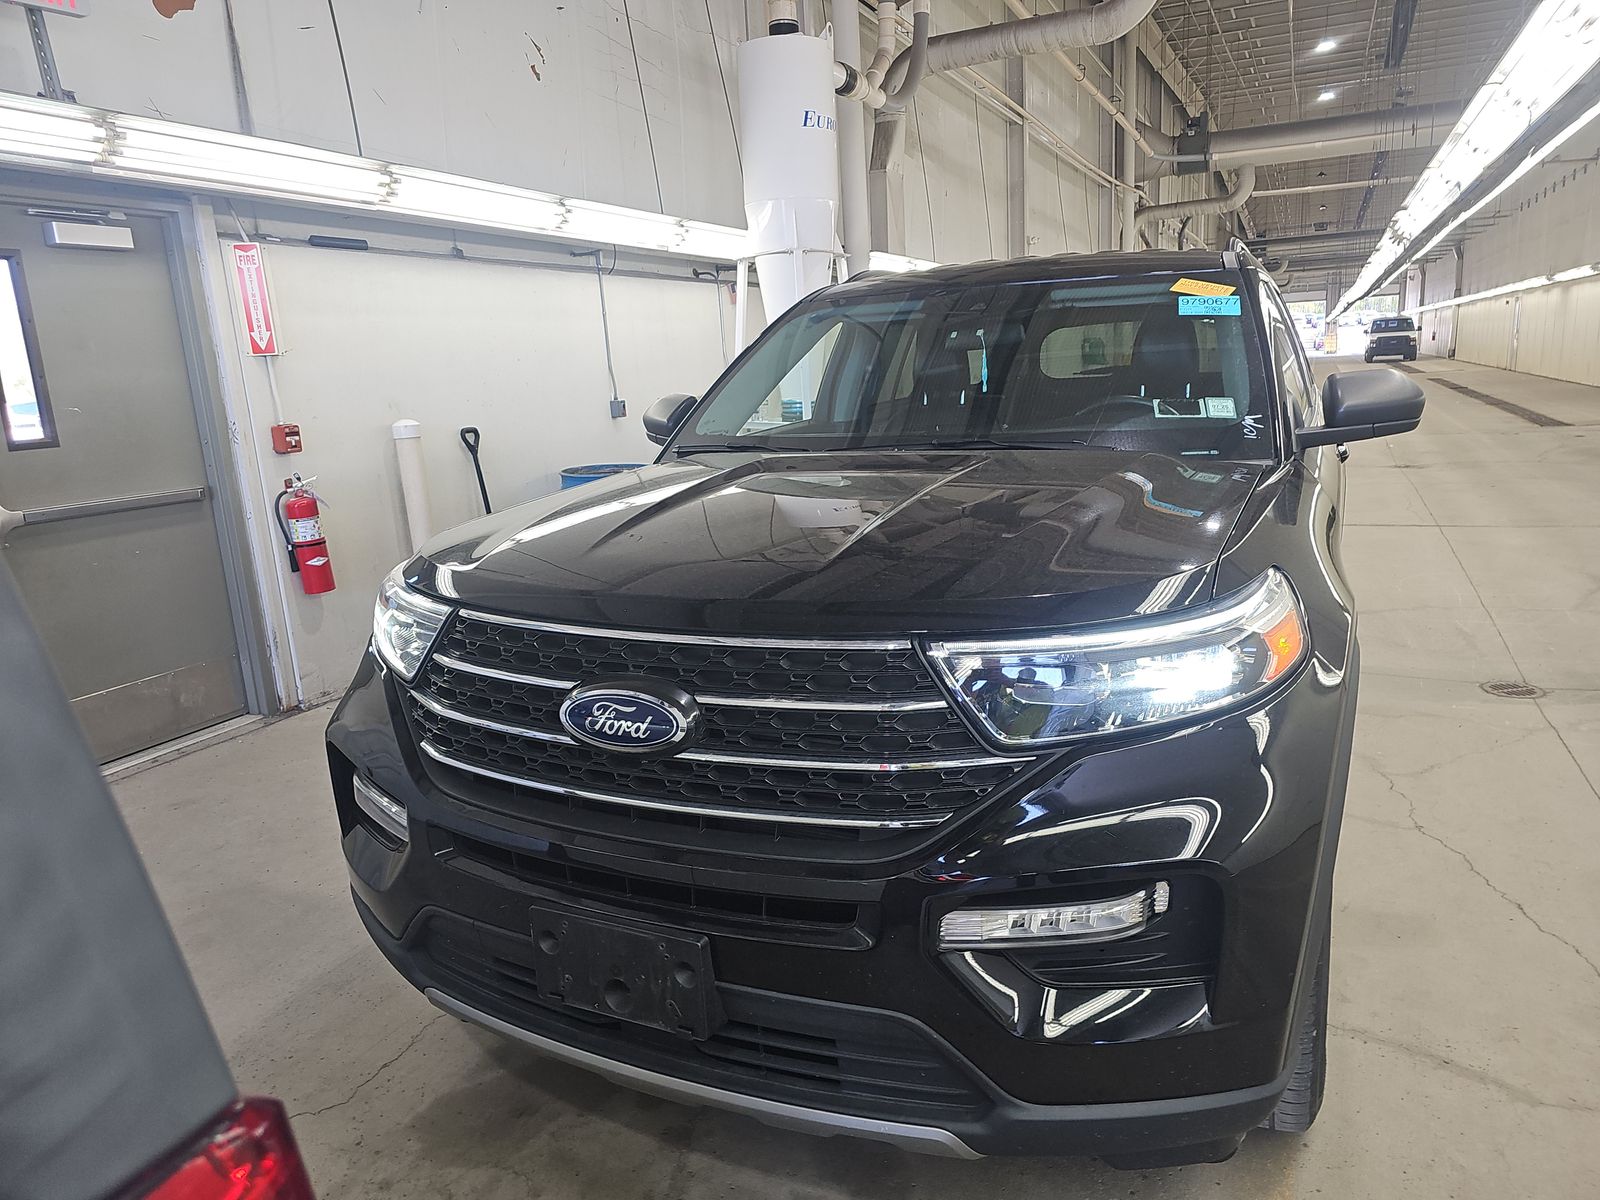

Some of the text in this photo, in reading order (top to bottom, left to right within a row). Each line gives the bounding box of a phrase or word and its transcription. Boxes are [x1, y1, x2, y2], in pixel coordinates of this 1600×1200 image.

[238, 254, 257, 266] FIRE
[247, 266, 265, 342] EXTINGUISHER
[1181, 297, 1239, 306] 9790677
[585, 701, 653, 739] Ford
